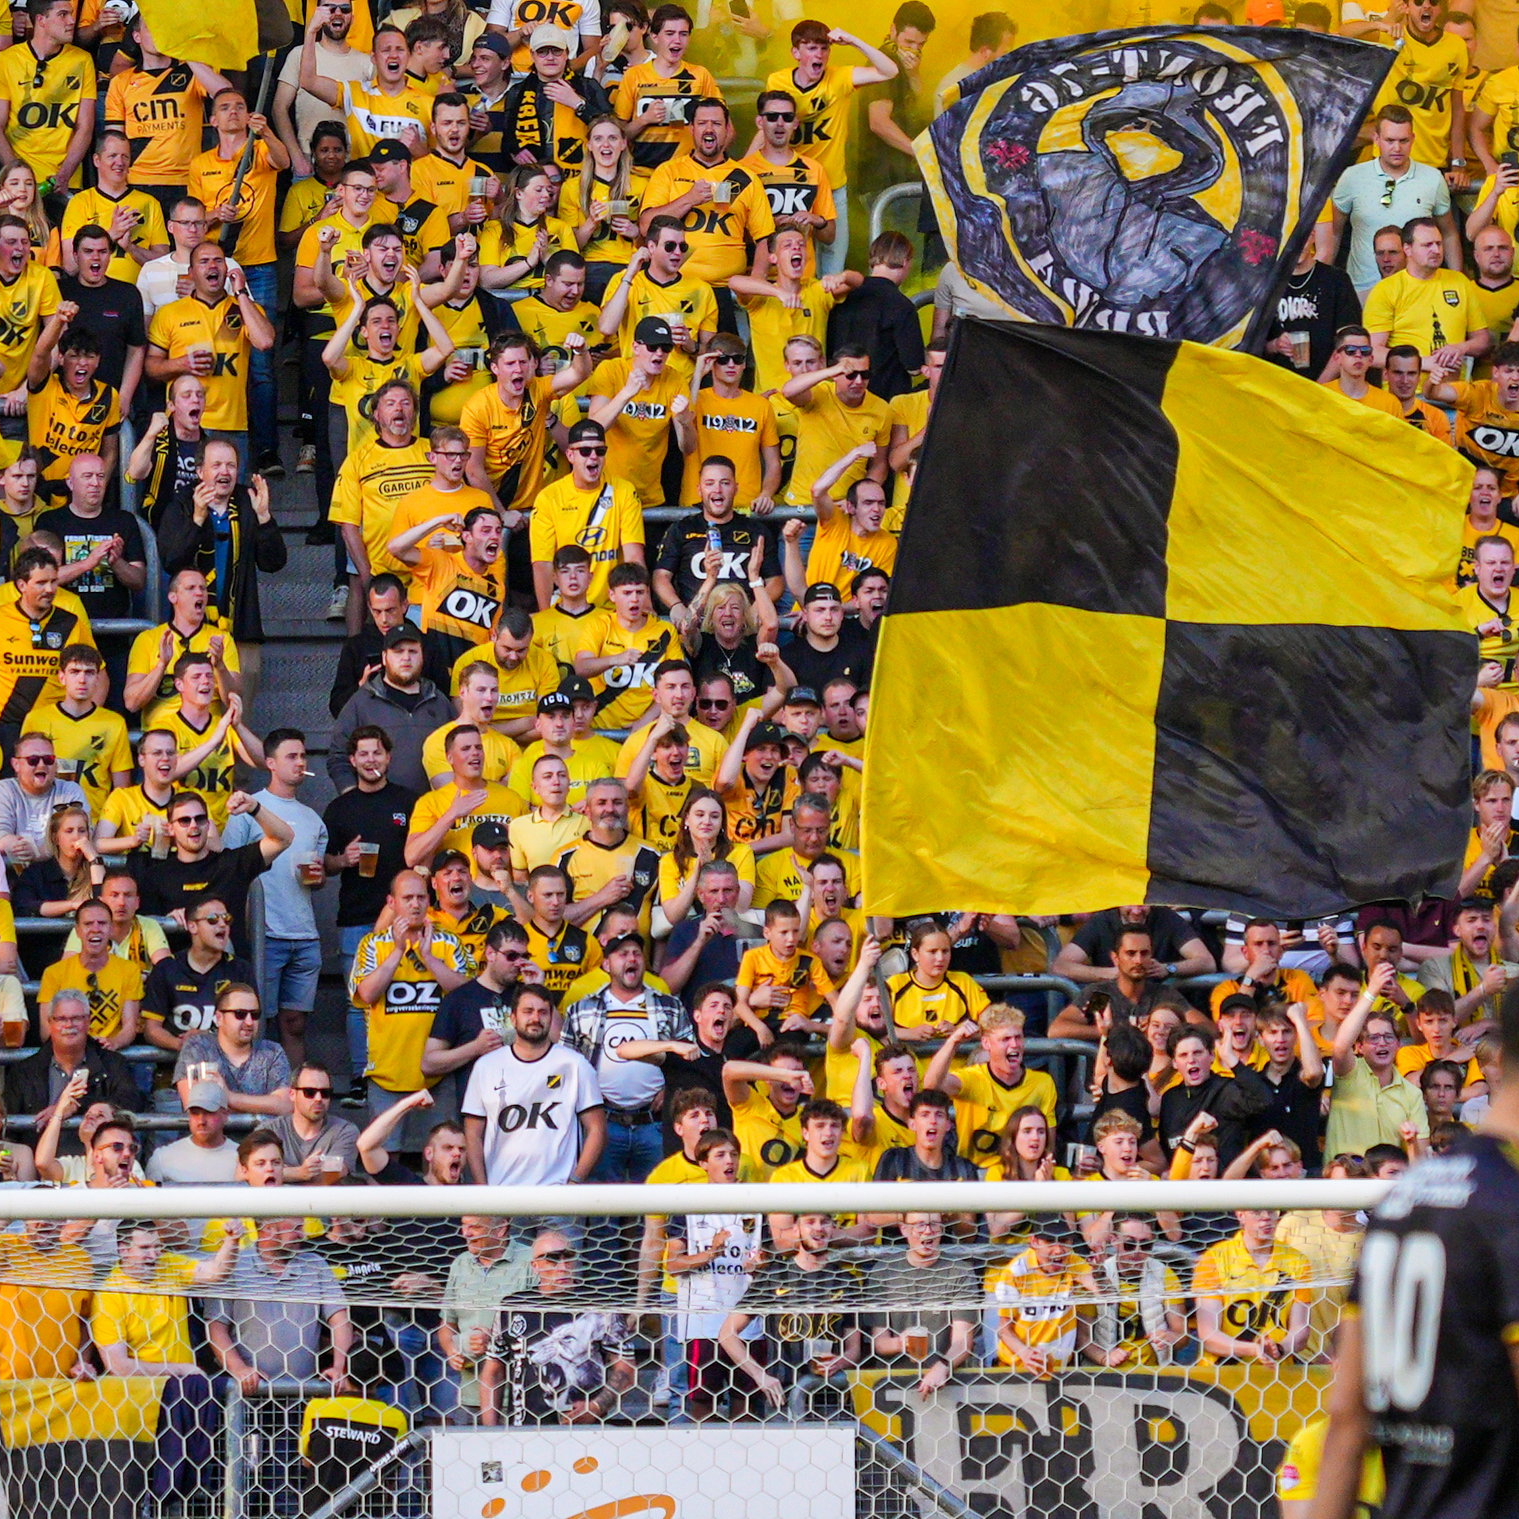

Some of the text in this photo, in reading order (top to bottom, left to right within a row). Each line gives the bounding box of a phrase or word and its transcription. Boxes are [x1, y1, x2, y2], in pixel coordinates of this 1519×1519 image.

[518, 0, 576, 24] OK
[1394, 79, 1448, 112] OK
[19, 104, 78, 129] OK
[136, 121, 186, 131] PAYMENTS
[764, 187, 810, 212] OK
[678, 209, 731, 235] OK
[49, 415, 90, 438] into
[705, 415, 755, 433] 1912
[383, 481, 421, 493] GARCIA
[691, 552, 749, 579] OK
[445, 588, 497, 626] OK
[606, 661, 656, 691] OK
[544, 694, 570, 705] ICON
[386, 981, 441, 1004] OZ
[499, 1102, 561, 1131] OK
[1228, 1298, 1284, 1326] OK
[325, 1426, 380, 1443] STEWARD
